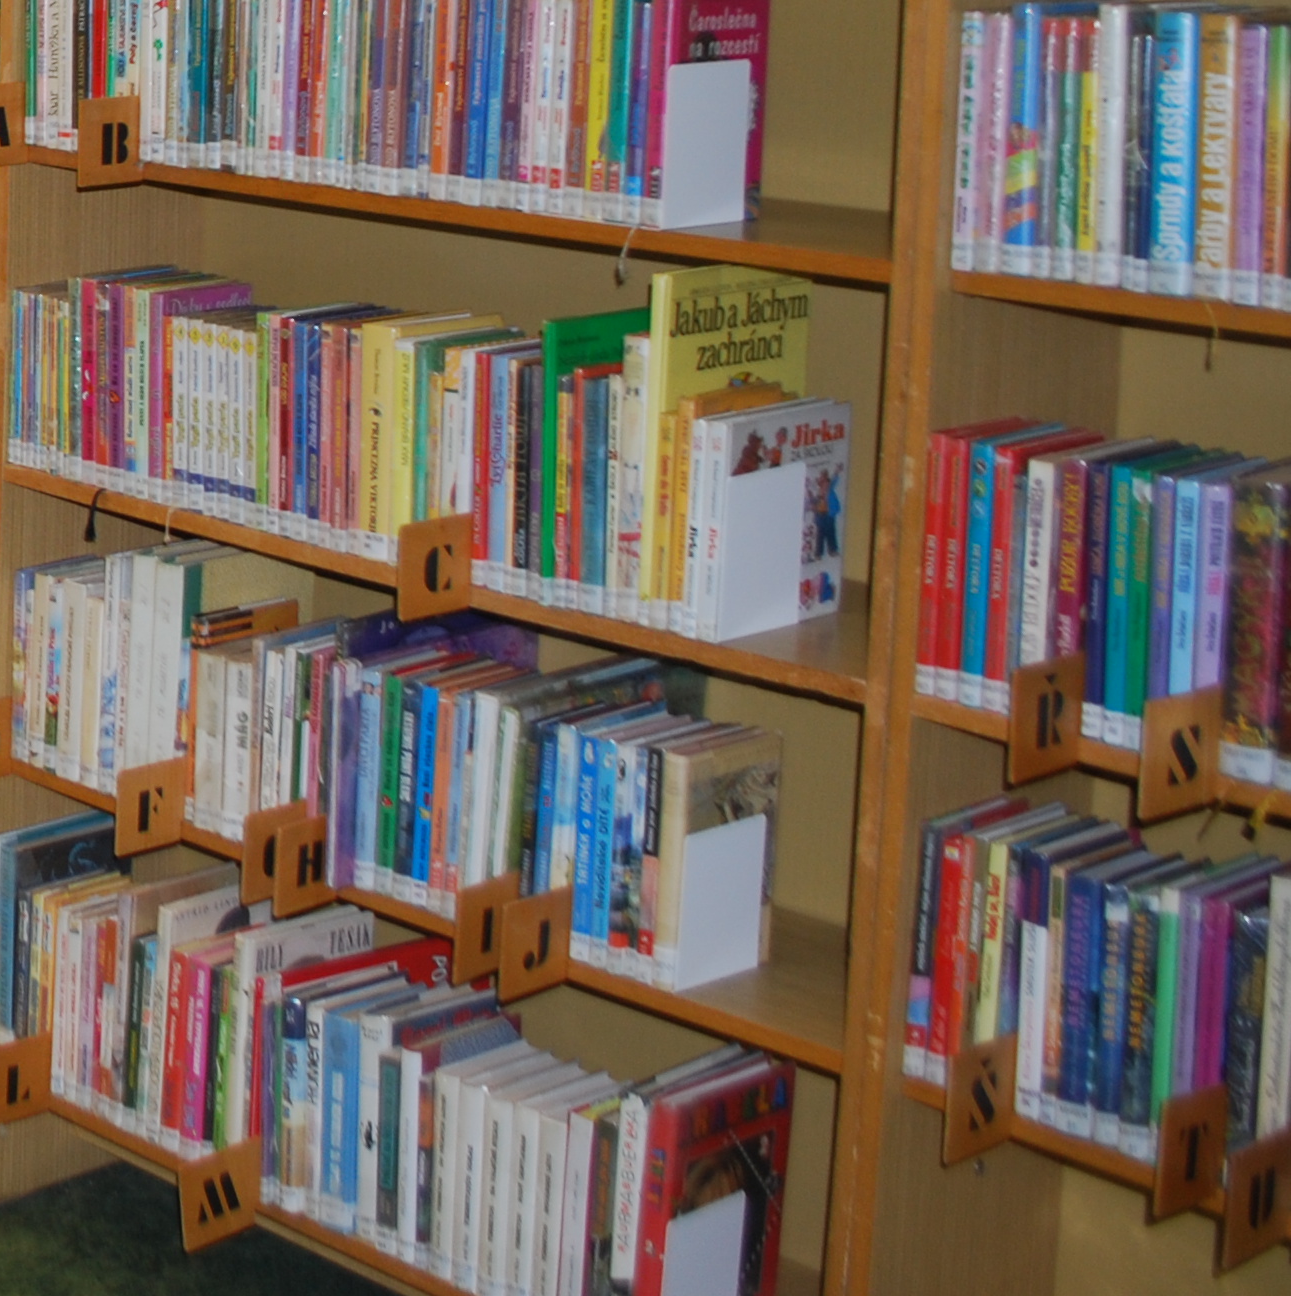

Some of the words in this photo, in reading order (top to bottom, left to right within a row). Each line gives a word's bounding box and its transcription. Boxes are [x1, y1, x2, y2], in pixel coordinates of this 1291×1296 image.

[101, 122, 129, 167] B
[1162, 162, 1182, 176] a
[1201, 188, 1222, 203] a
[669, 294, 725, 339] Jakub
[728, 307, 738, 327] a
[741, 288, 810, 330] Jáchym
[696, 326, 784, 372] zachránci
[791, 418, 845, 448] Jirka
[424, 543, 452, 594] C
[234, 711, 249, 749] MÁG
[1167, 724, 1202, 786] S
[138, 787, 164, 833] F
[297, 840, 324, 880] H
[523, 919, 550, 971] J
[6, 1064, 31, 1105] L
[1182, 1121, 1207, 1182] T
[197, 1171, 241, 1224] M
